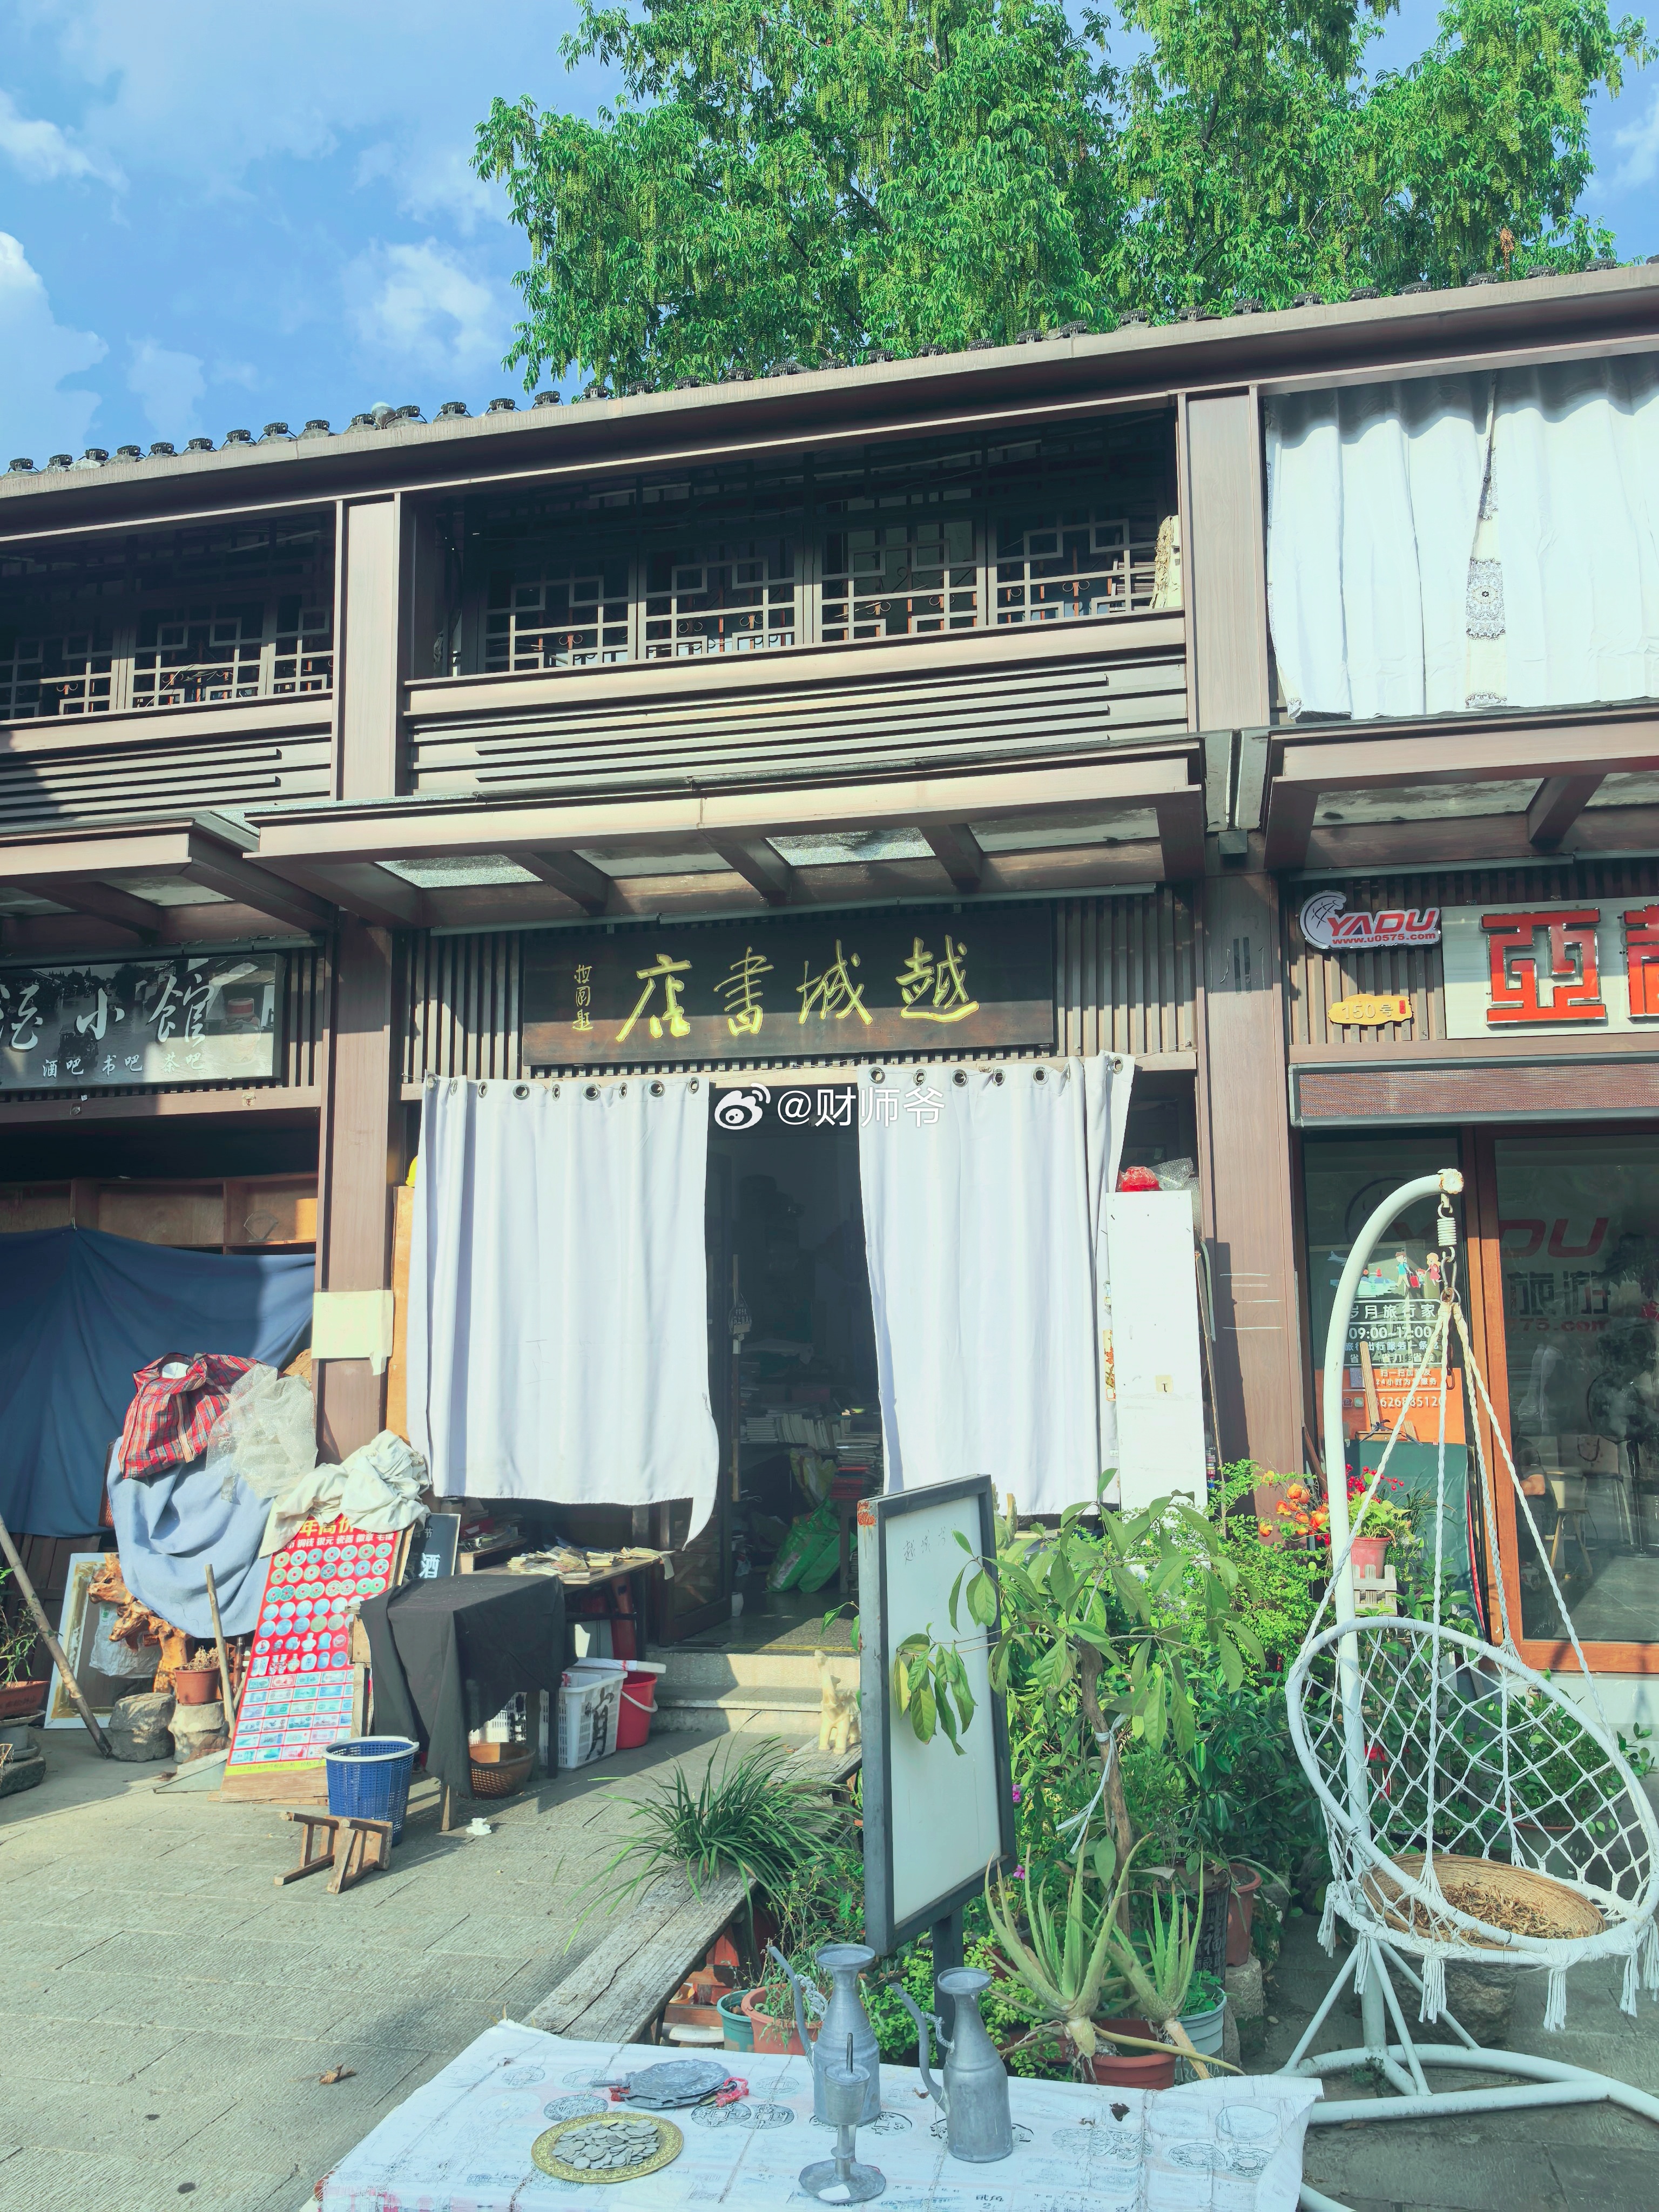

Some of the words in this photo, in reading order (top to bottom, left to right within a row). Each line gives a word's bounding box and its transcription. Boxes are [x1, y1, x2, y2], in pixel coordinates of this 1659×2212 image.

[1327, 911, 1436, 936] YADU
[1332, 932, 1436, 945] www.u0575.com
[1342, 1003, 1393, 1020] 150号
[42, 1058, 84, 1077] 酒吧
[102, 1054, 143, 1076] 书吧
[164, 1051, 205, 1073] 茶吧
[1376, 1378, 1437, 1386] 24小时为服务
[316, 1536, 334, 1546] 银元
[336, 1534, 354, 1544] 瓷器
[419, 1552, 441, 1578] 酒
